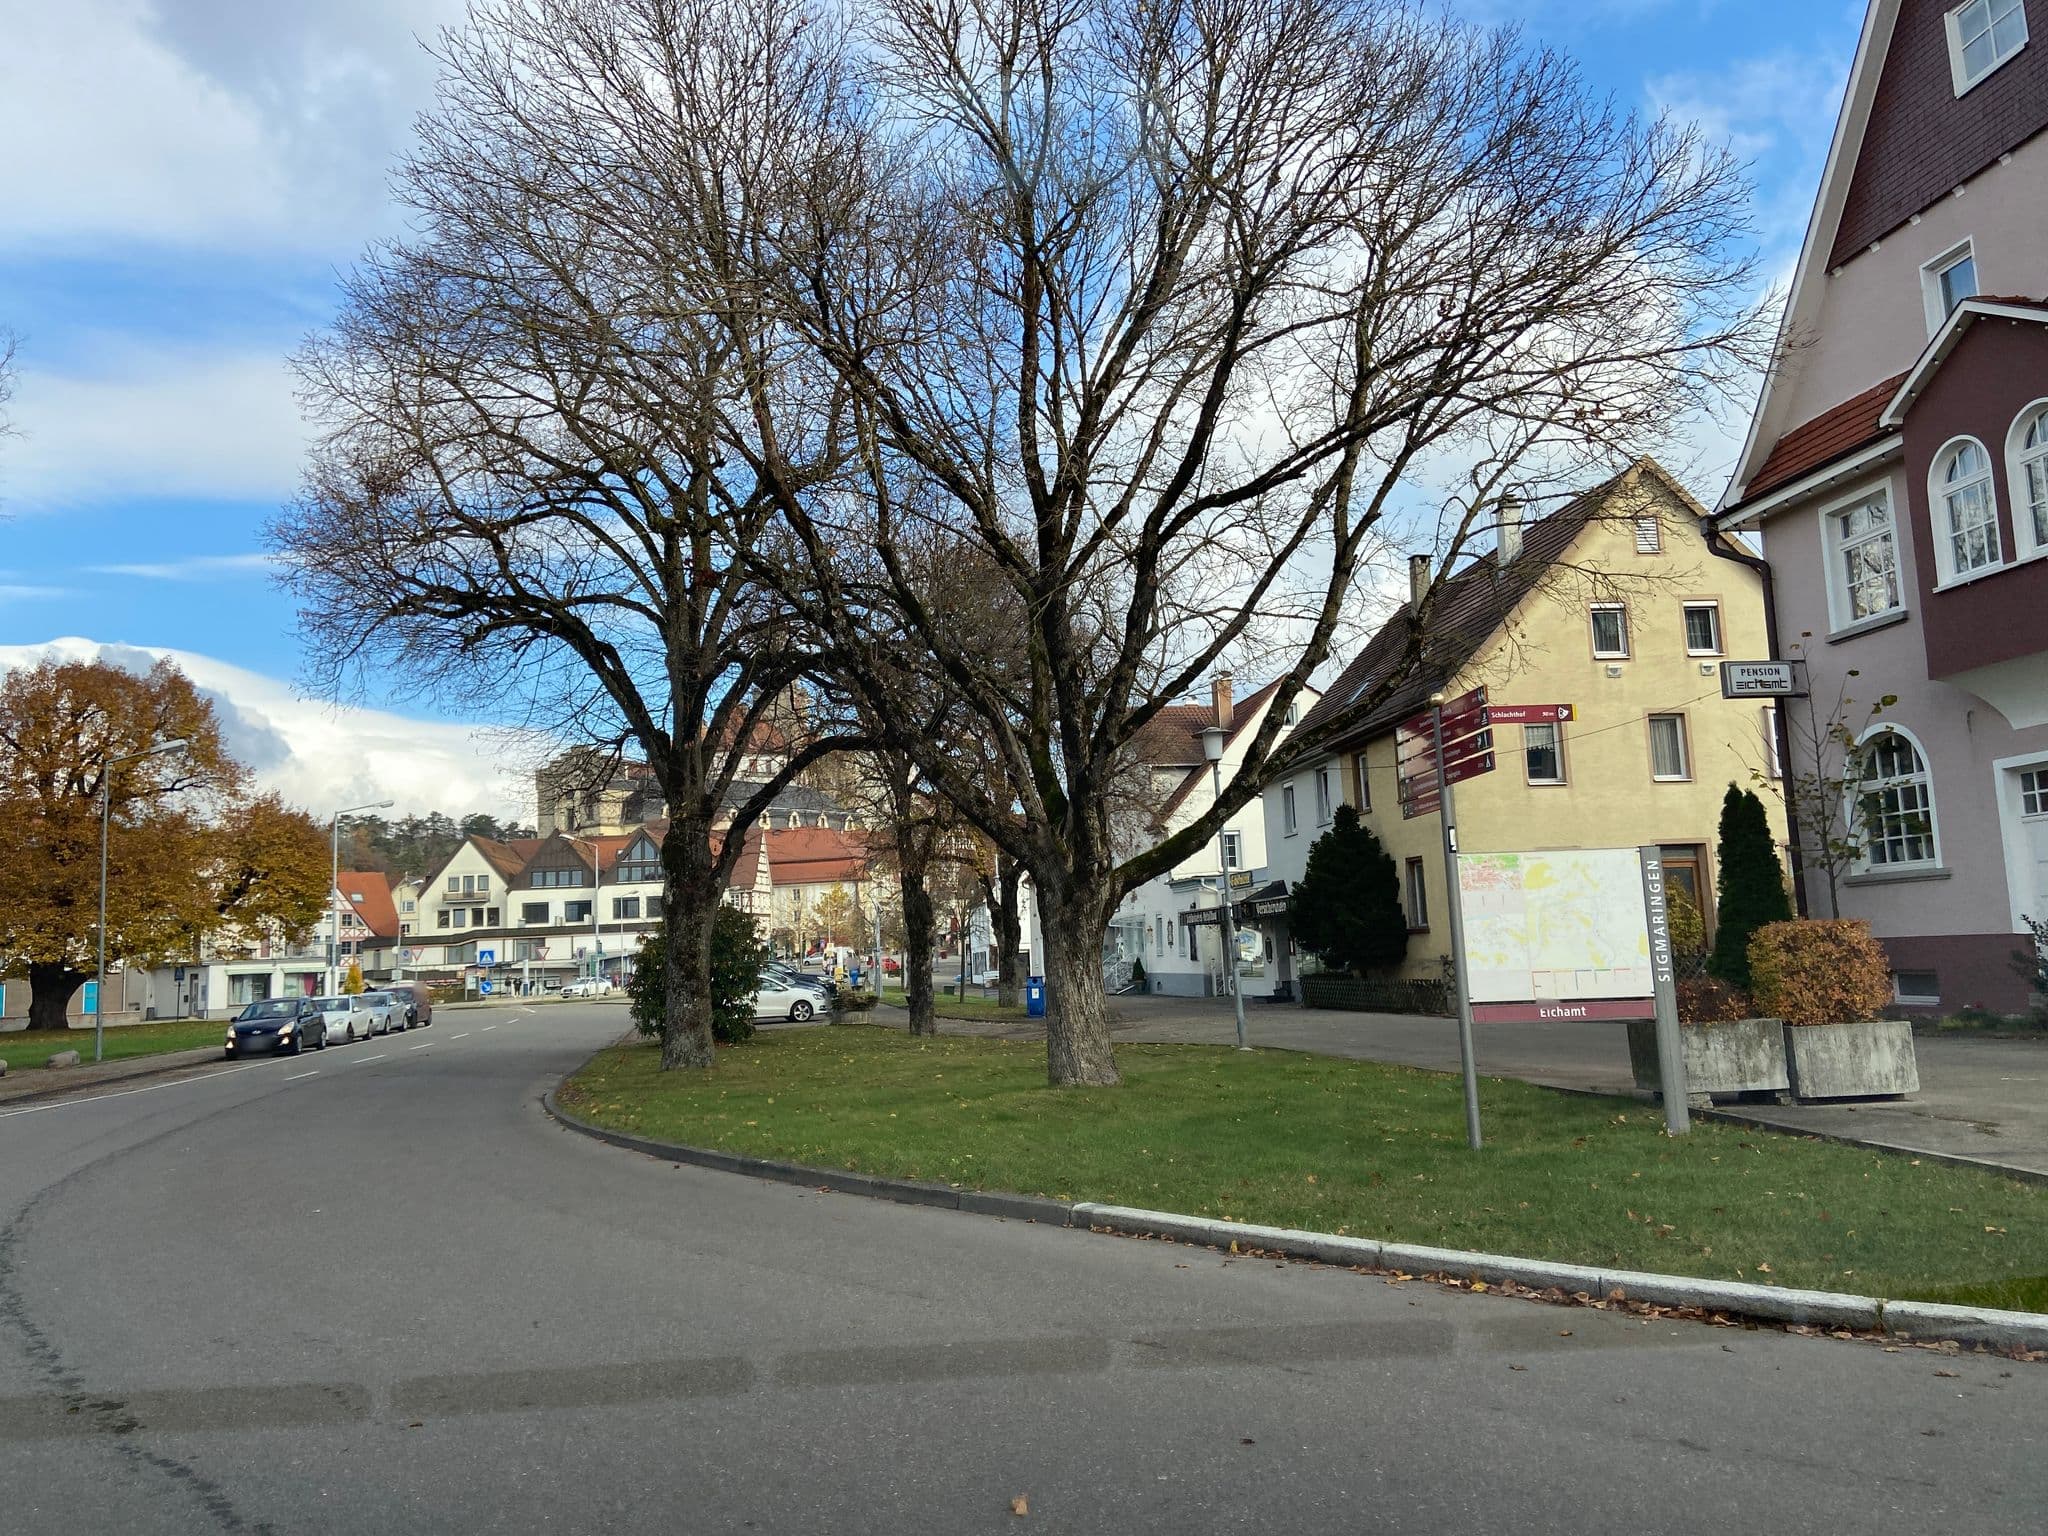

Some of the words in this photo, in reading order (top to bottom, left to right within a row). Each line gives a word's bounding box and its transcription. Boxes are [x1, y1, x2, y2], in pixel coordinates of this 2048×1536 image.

[1740, 668, 1780, 677] PENSION
[1646, 860, 1671, 983] SIGMARINGEN
[1539, 1006, 1587, 1018] Eichamt
